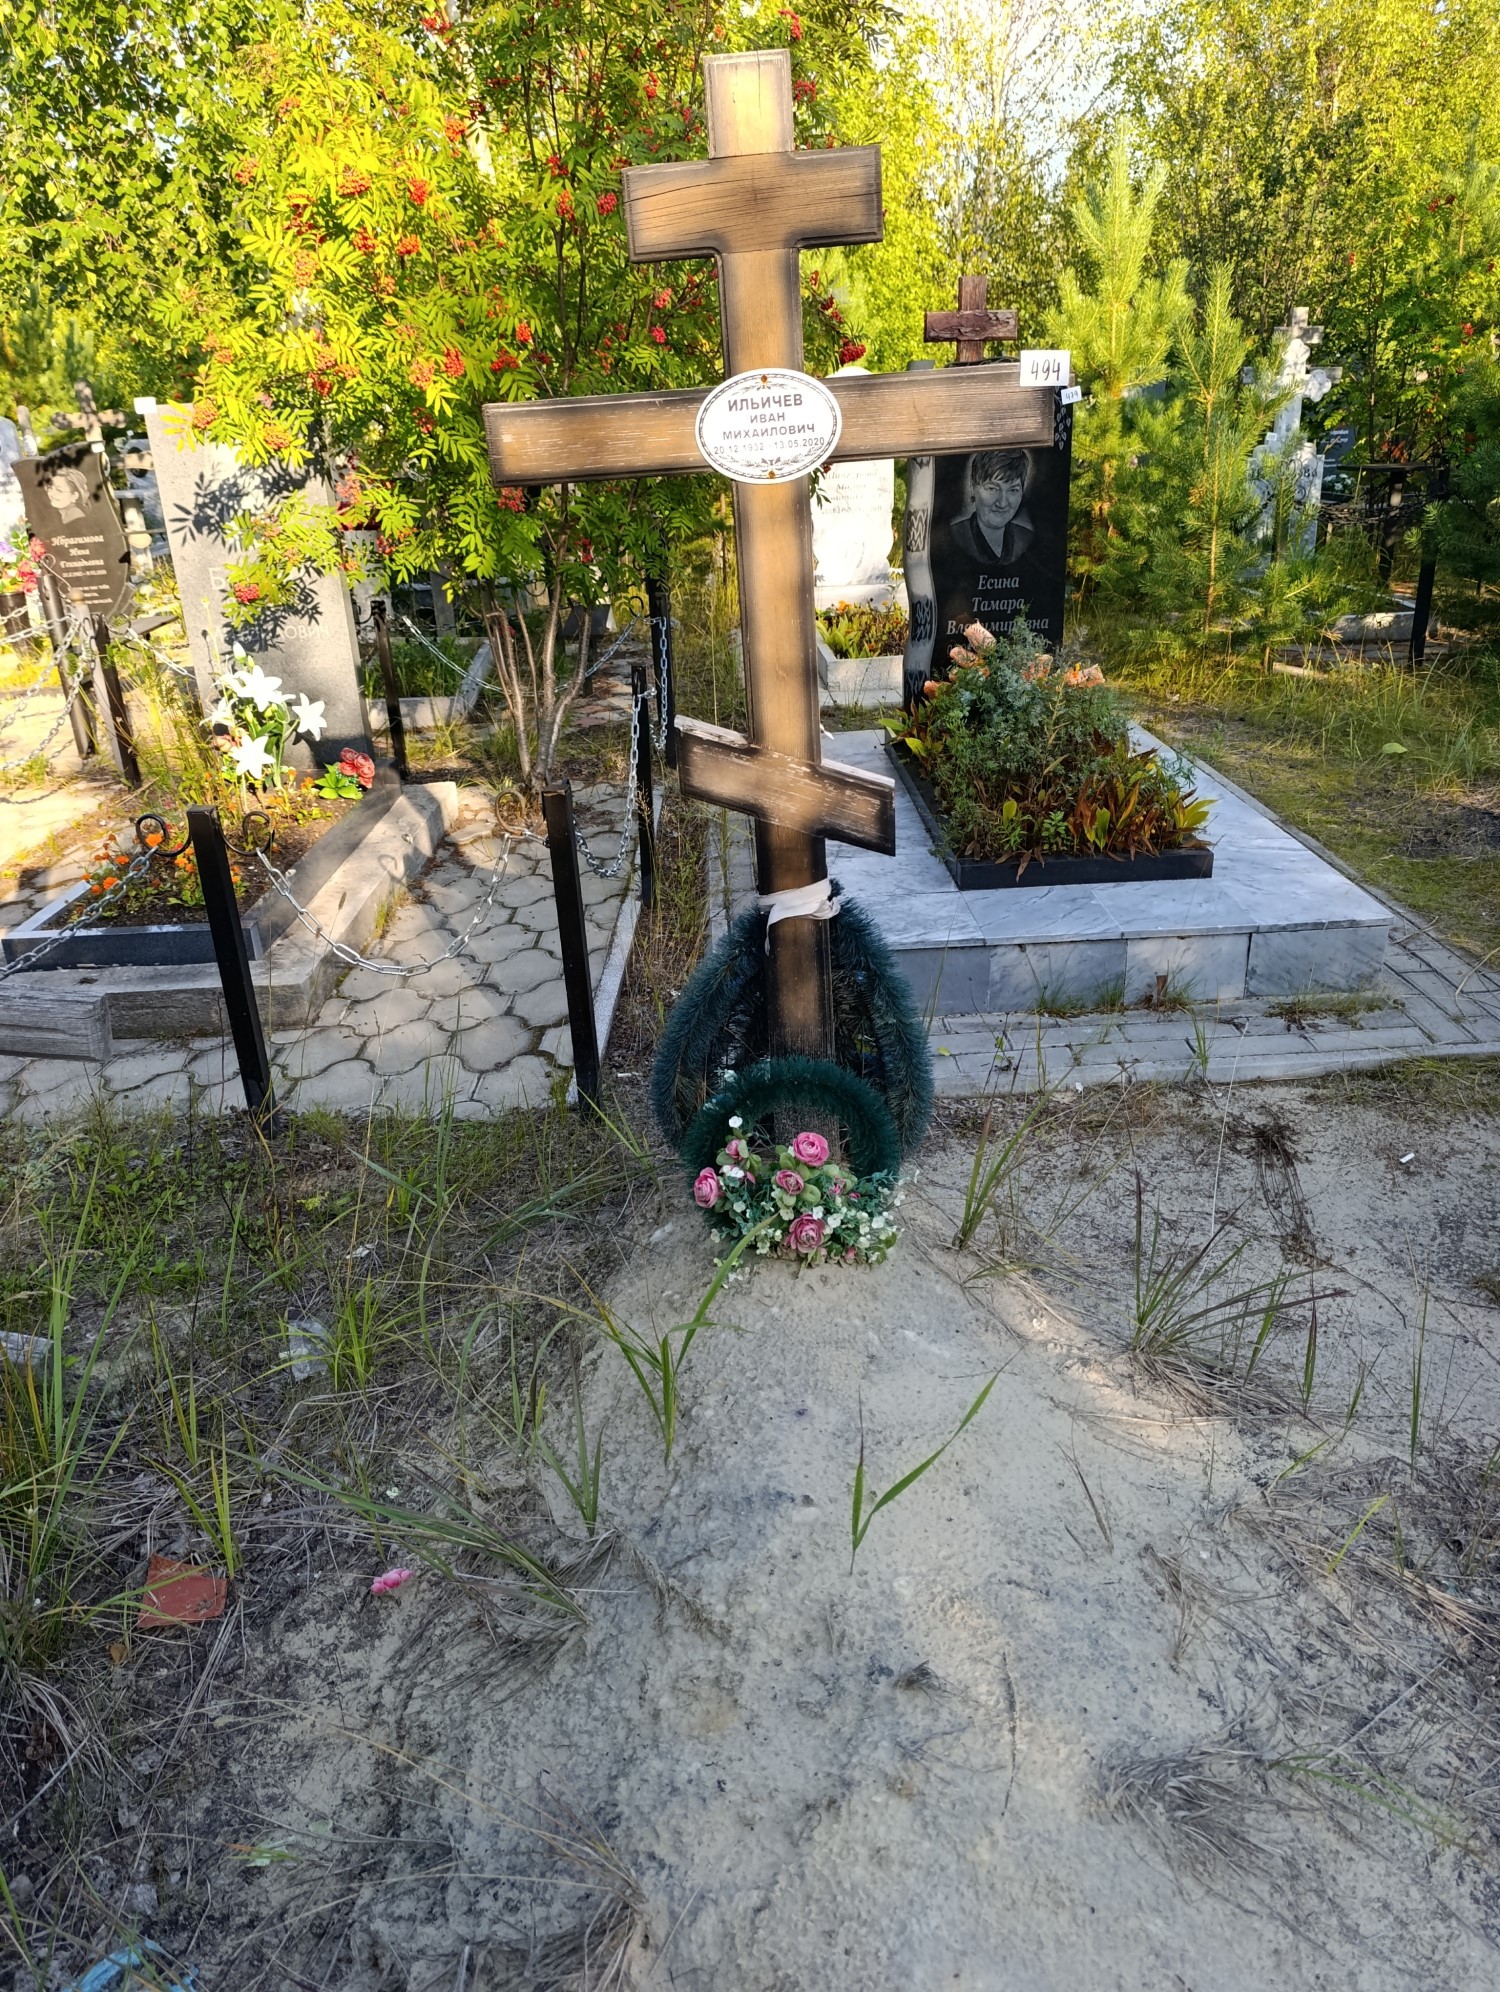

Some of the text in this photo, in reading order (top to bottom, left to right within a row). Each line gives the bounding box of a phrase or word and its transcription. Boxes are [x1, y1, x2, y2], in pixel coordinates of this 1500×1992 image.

[1031, 359, 1061, 381] 494
[728, 393, 803, 412] ИЛЬИЧЕВ
[750, 412, 786, 424] ИВАН
[722, 424, 815, 440] МИХАИЛОВИЧ
[978, 575, 1020, 590] Есина
[972, 597, 1025, 614] Тамара
